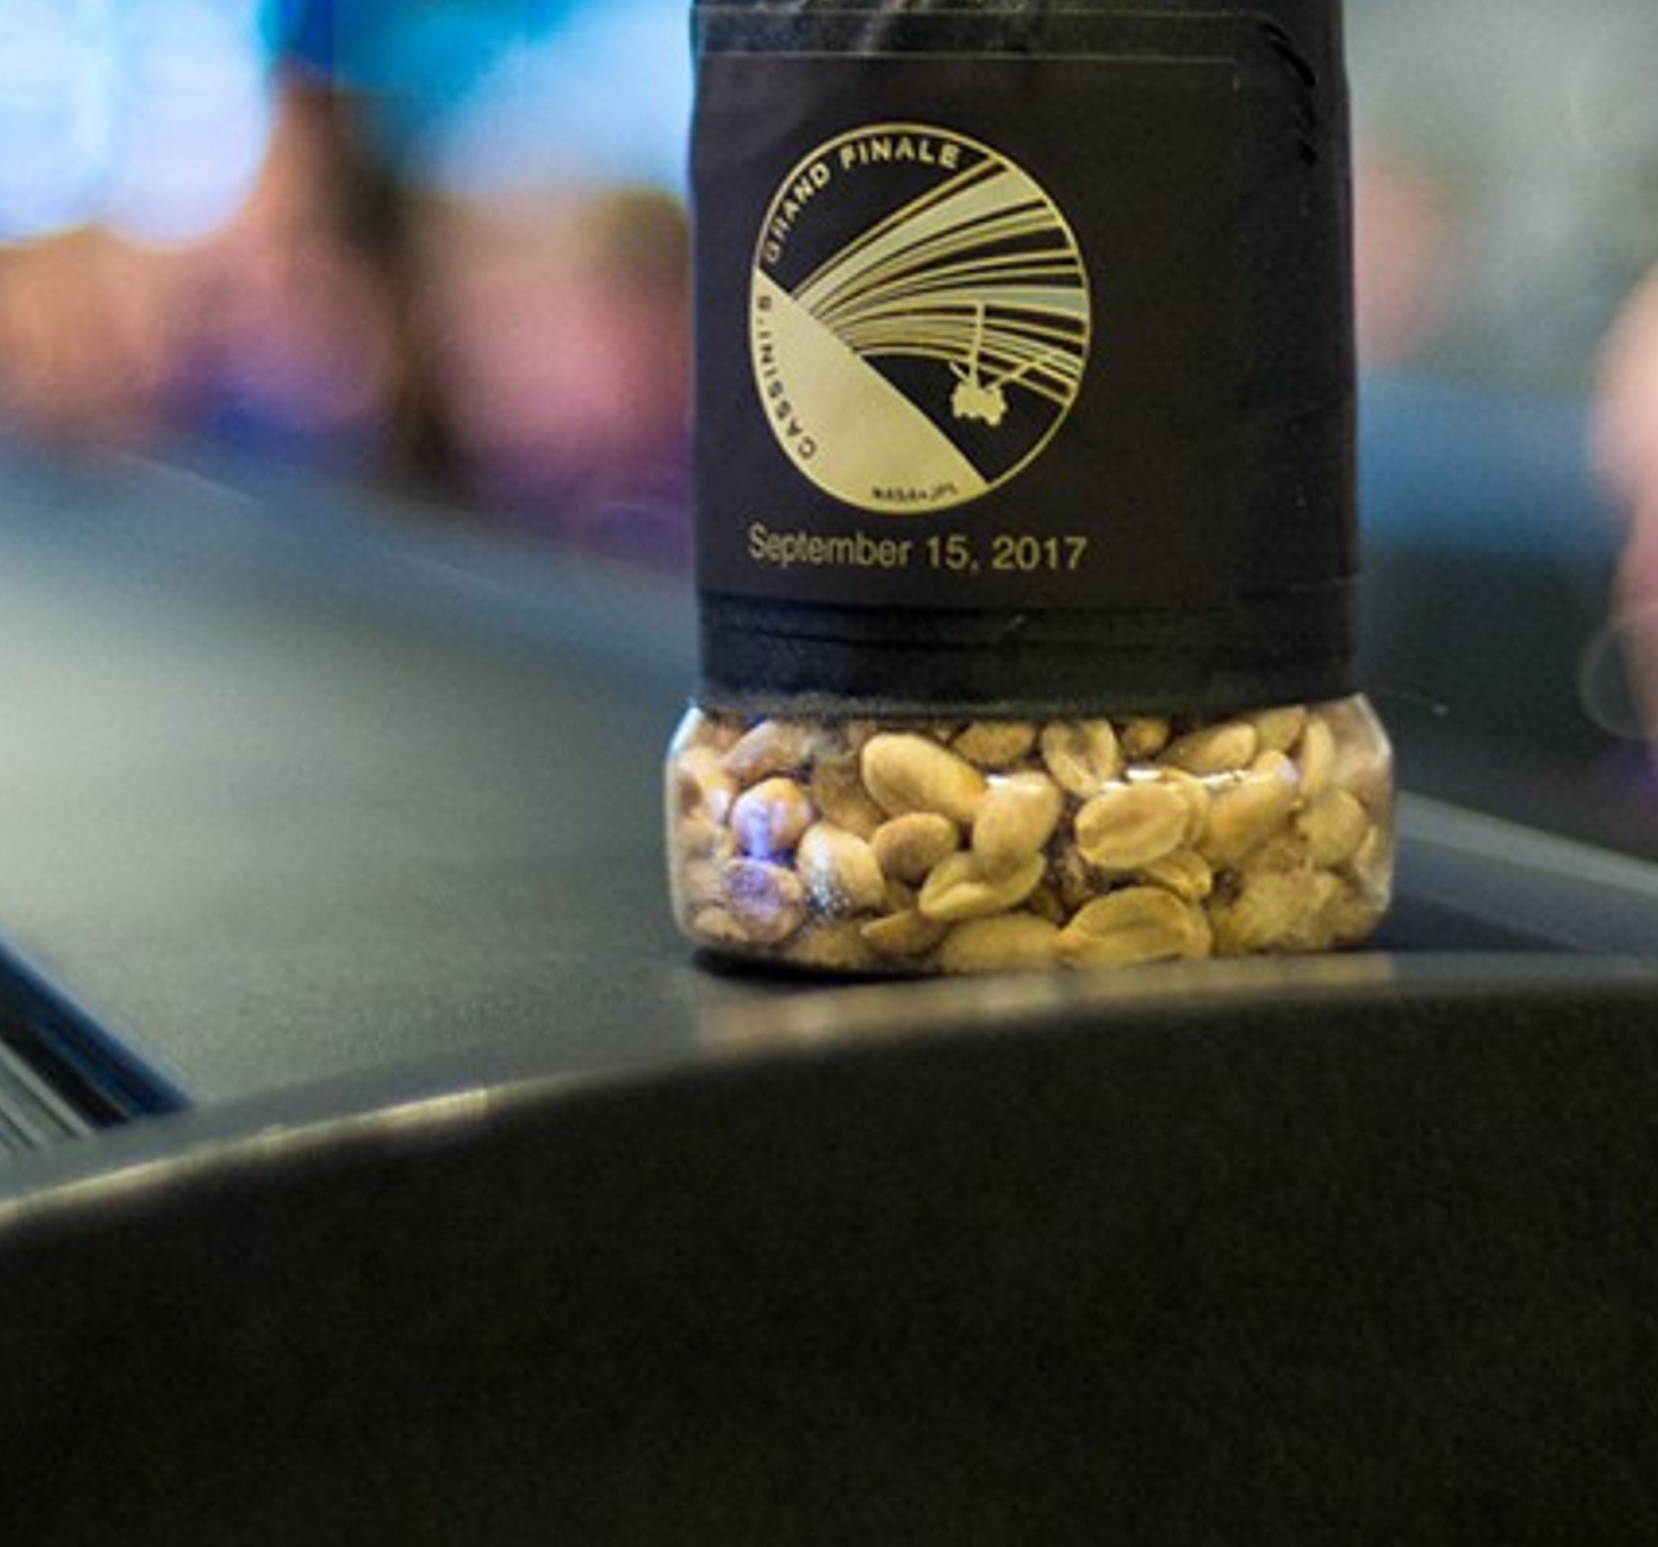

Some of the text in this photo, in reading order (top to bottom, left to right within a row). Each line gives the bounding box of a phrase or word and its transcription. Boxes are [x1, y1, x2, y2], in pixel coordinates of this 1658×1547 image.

[765, 162, 831, 263] GRAND
[839, 136, 961, 170] FINALE
[748, 522, 1088, 572] September 15, 2017
